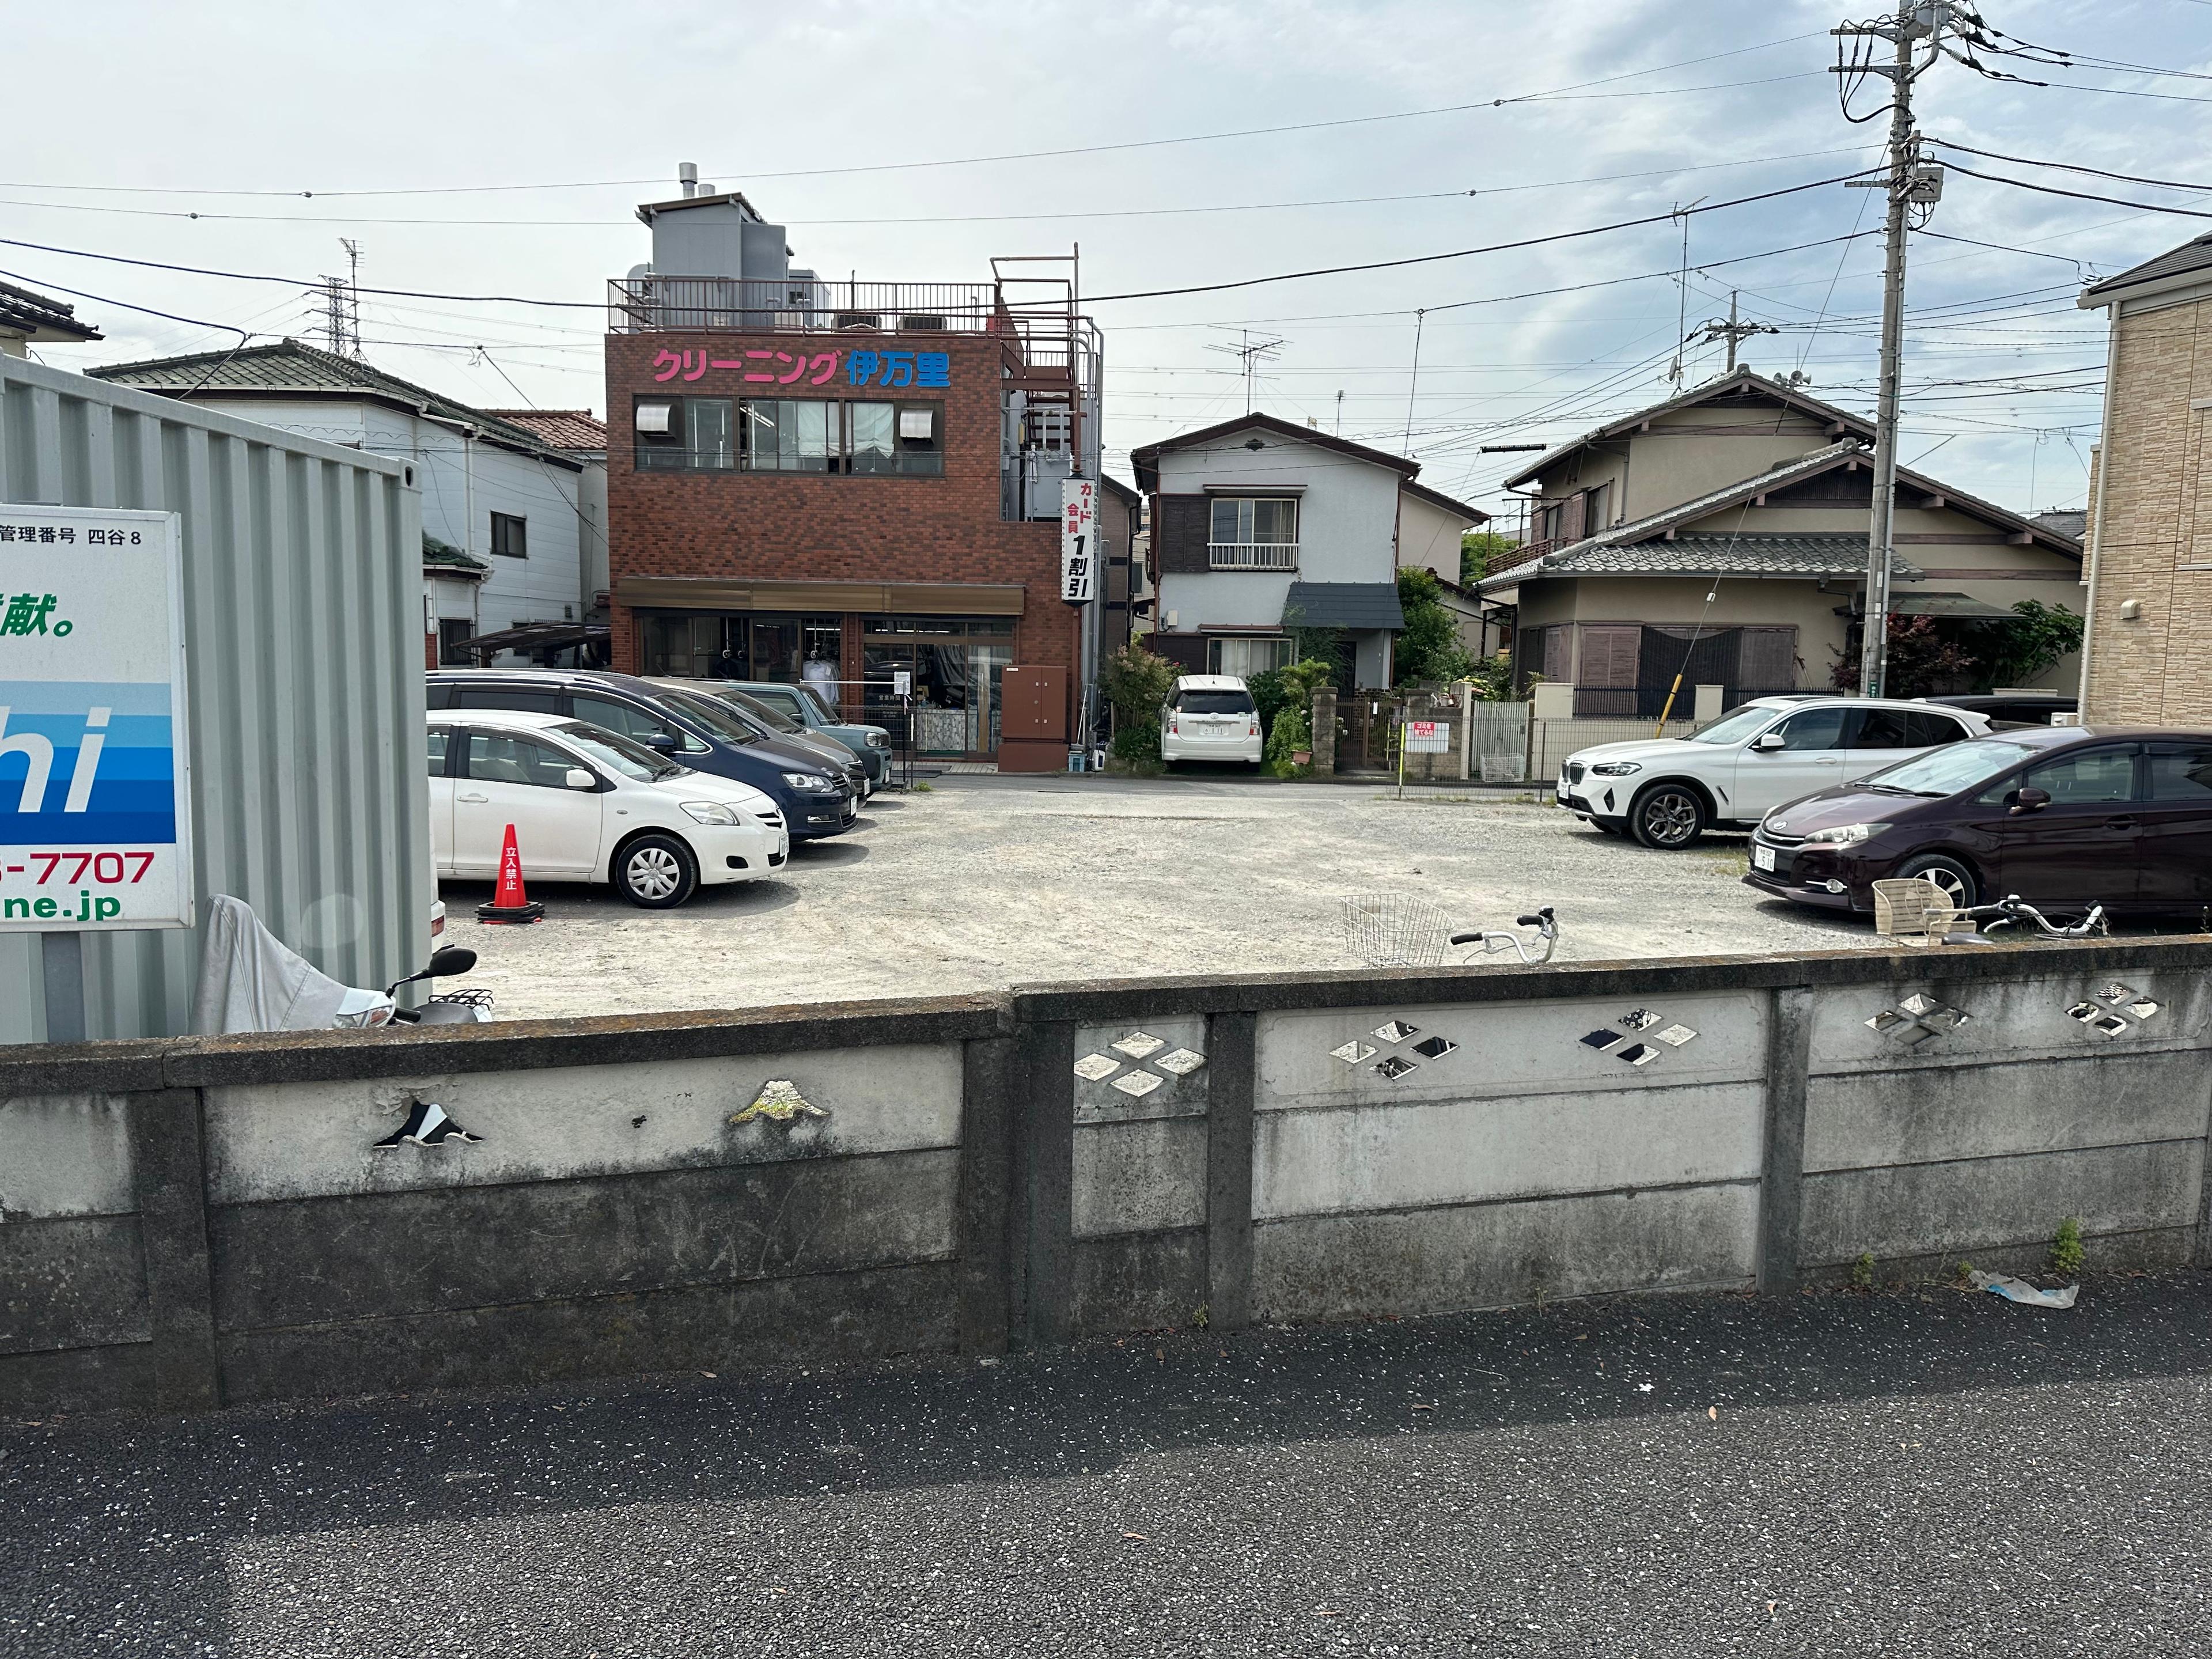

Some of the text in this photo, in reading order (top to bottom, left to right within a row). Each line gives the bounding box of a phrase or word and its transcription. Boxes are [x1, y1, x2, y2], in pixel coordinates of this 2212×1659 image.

[1067, 503, 1080, 533] 会員
[1080, 483, 1092, 524] カード
[0, 525, 142, 545] 管理番号 四谷8
[1068, 535, 1088, 597] 1割引
[0, 593, 73, 637] 献。
[0, 851, 154, 885] -7707
[505, 847, 517, 890] 立入禁止
[4, 890, 120, 921] ne.jp
